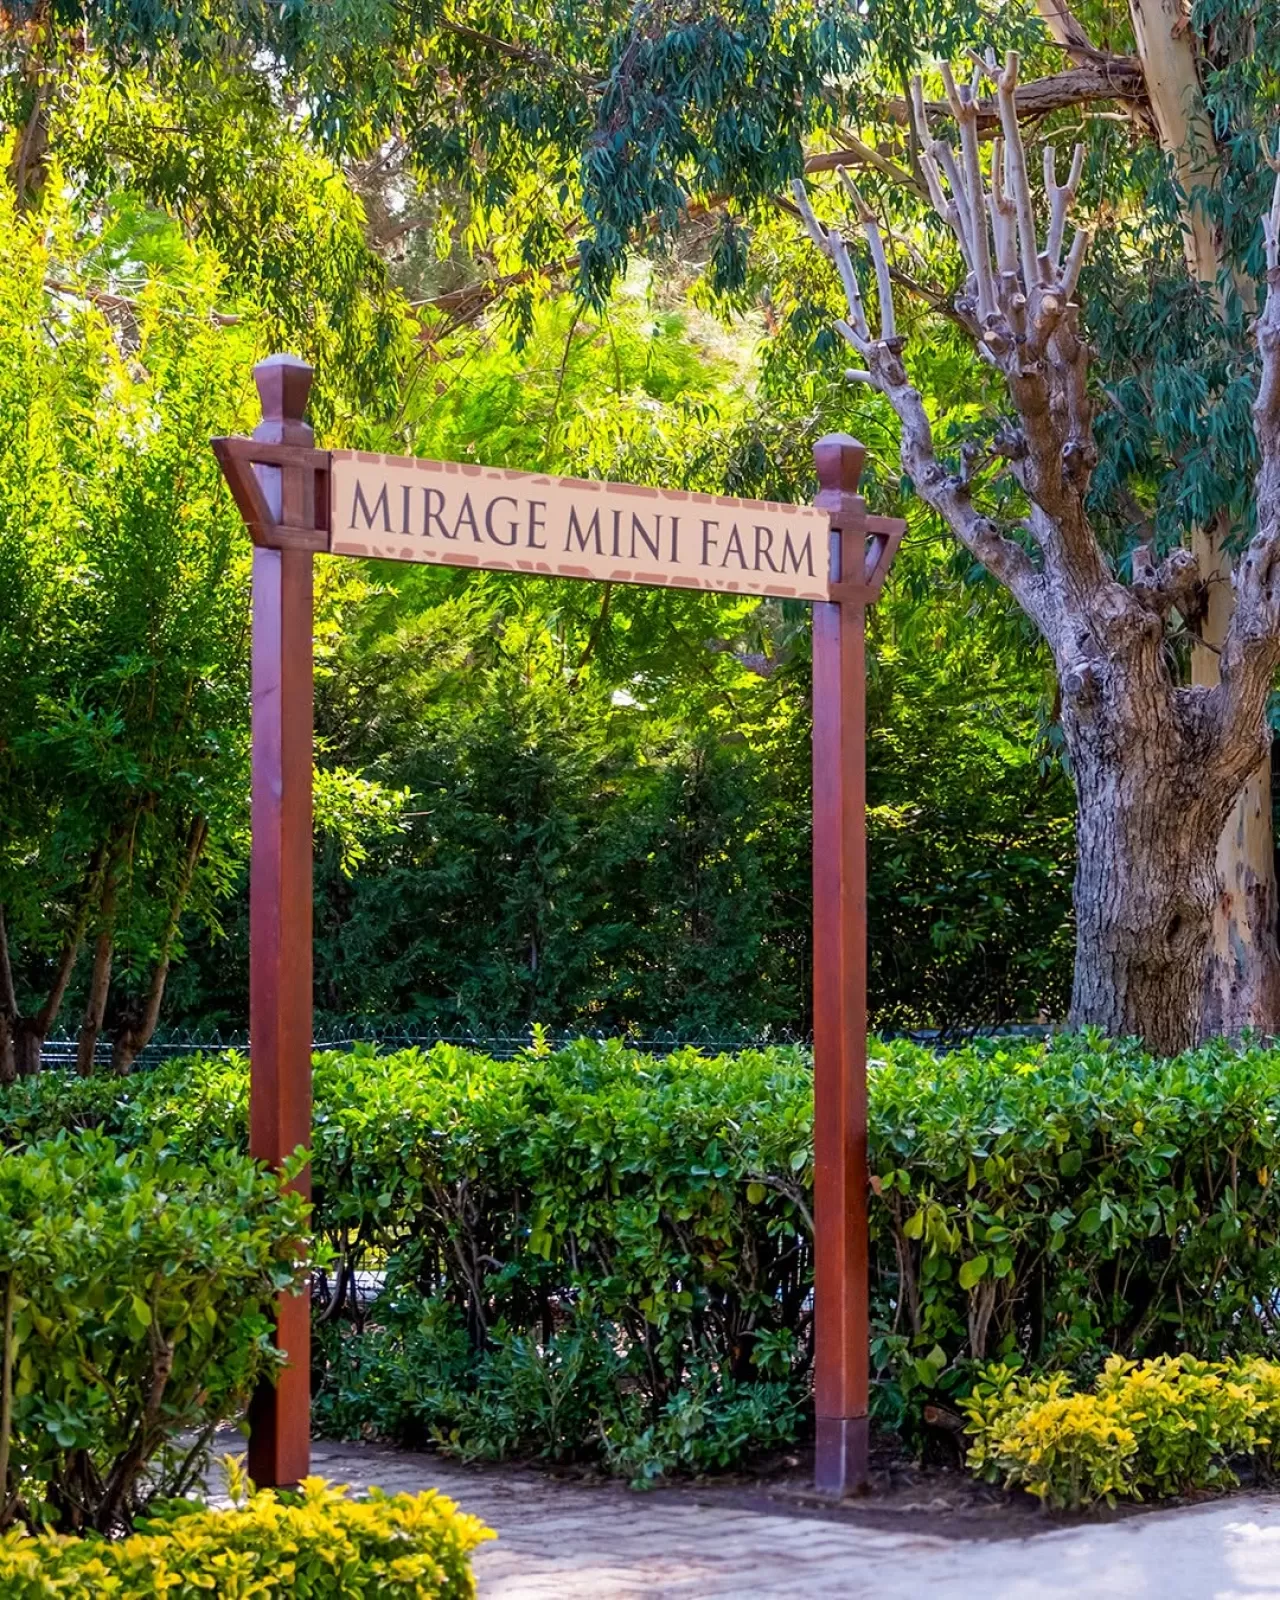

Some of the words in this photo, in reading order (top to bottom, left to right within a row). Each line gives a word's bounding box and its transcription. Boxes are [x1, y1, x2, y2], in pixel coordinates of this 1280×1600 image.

[348, 479, 547, 549] MIRAGE
[562, 504, 682, 563] MINI
[698, 519, 817, 578] FARM
